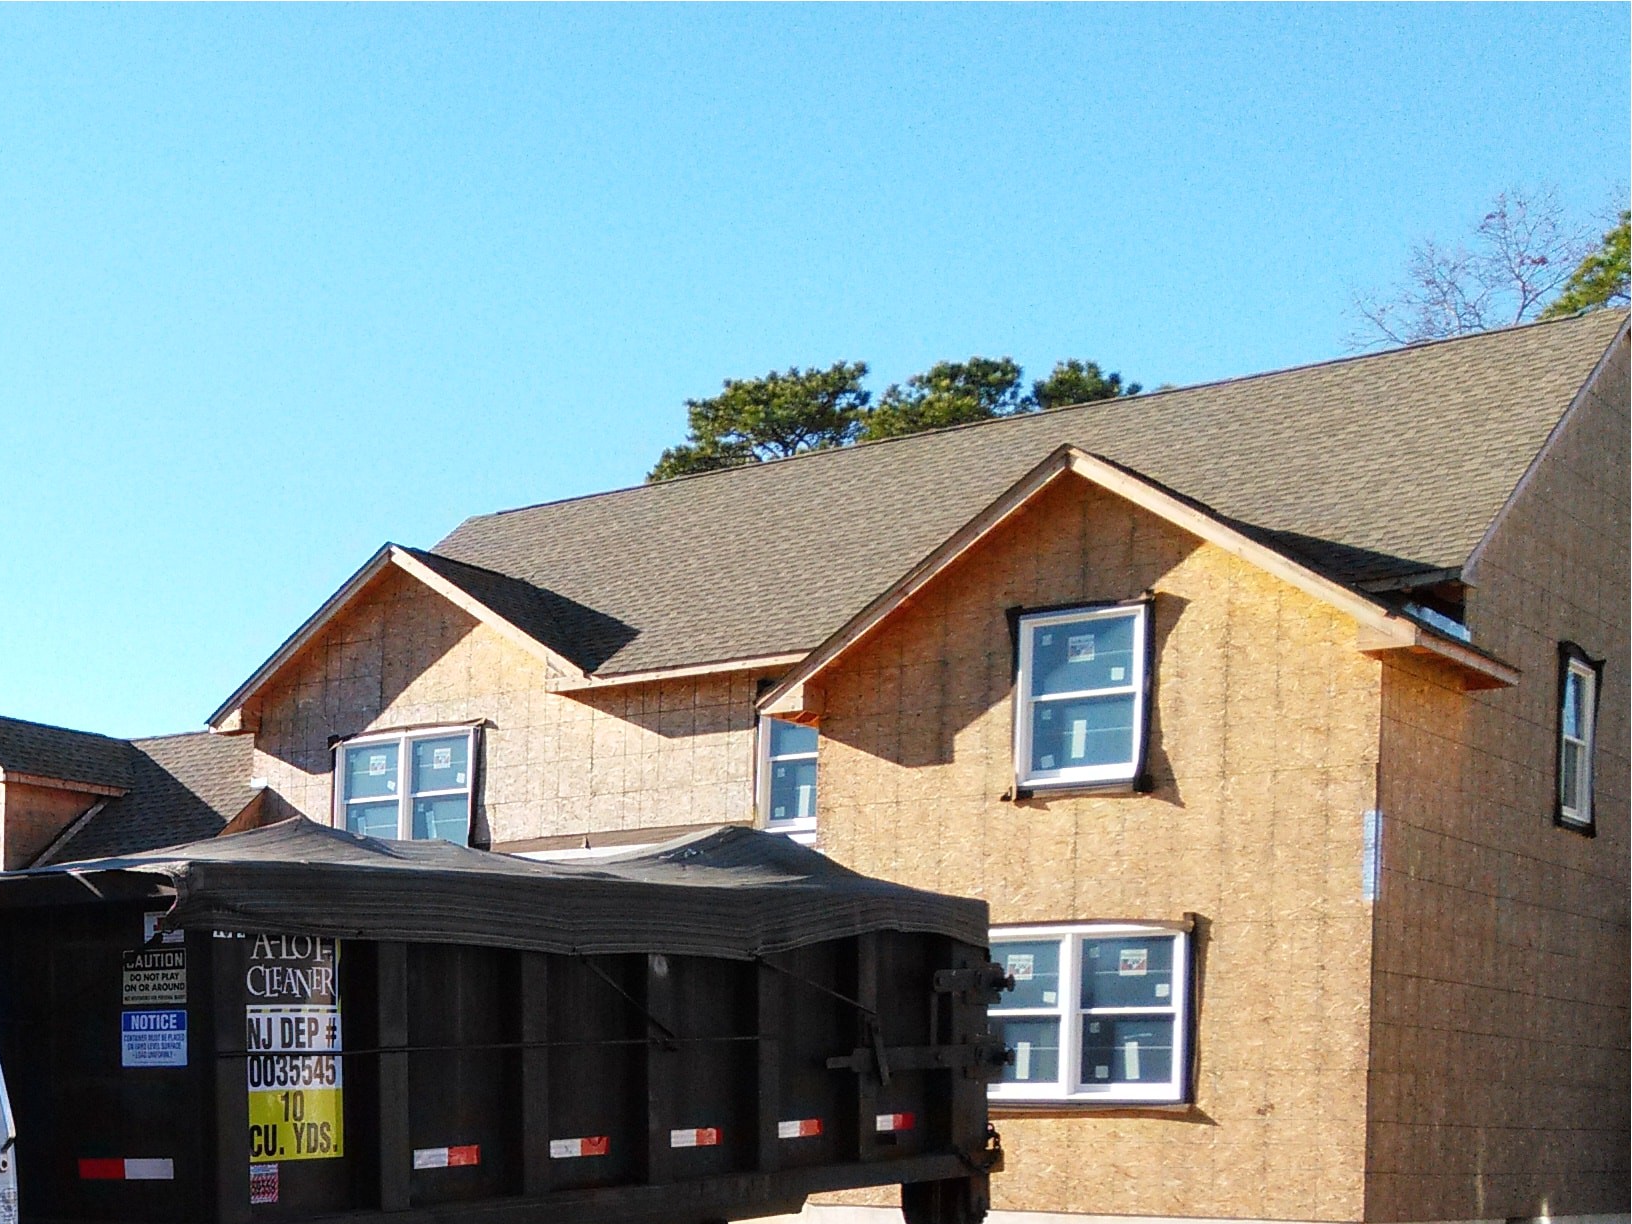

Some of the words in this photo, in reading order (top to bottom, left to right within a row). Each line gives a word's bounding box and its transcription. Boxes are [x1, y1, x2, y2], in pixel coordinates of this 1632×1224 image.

[124, 984, 137, 992] ON
[139, 983, 150, 992] OR
[152, 982, 185, 992] AROUND
[130, 973, 141, 982] DO
[144, 972, 160, 982] NOT
[161, 972, 179, 981] PLAY
[247, 964, 336, 998] CLEANER
[131, 1013, 177, 1030] NOTICE
[248, 1017, 272, 1050] NJ
[280, 1016, 319, 1049] DEP
[325, 1017, 337, 1048] #
[249, 1055, 337, 1087] 0035545
[280, 1090, 305, 1122] 10
[250, 1123, 285, 1157] CU.
[293, 1121, 338, 1154] YDS.
